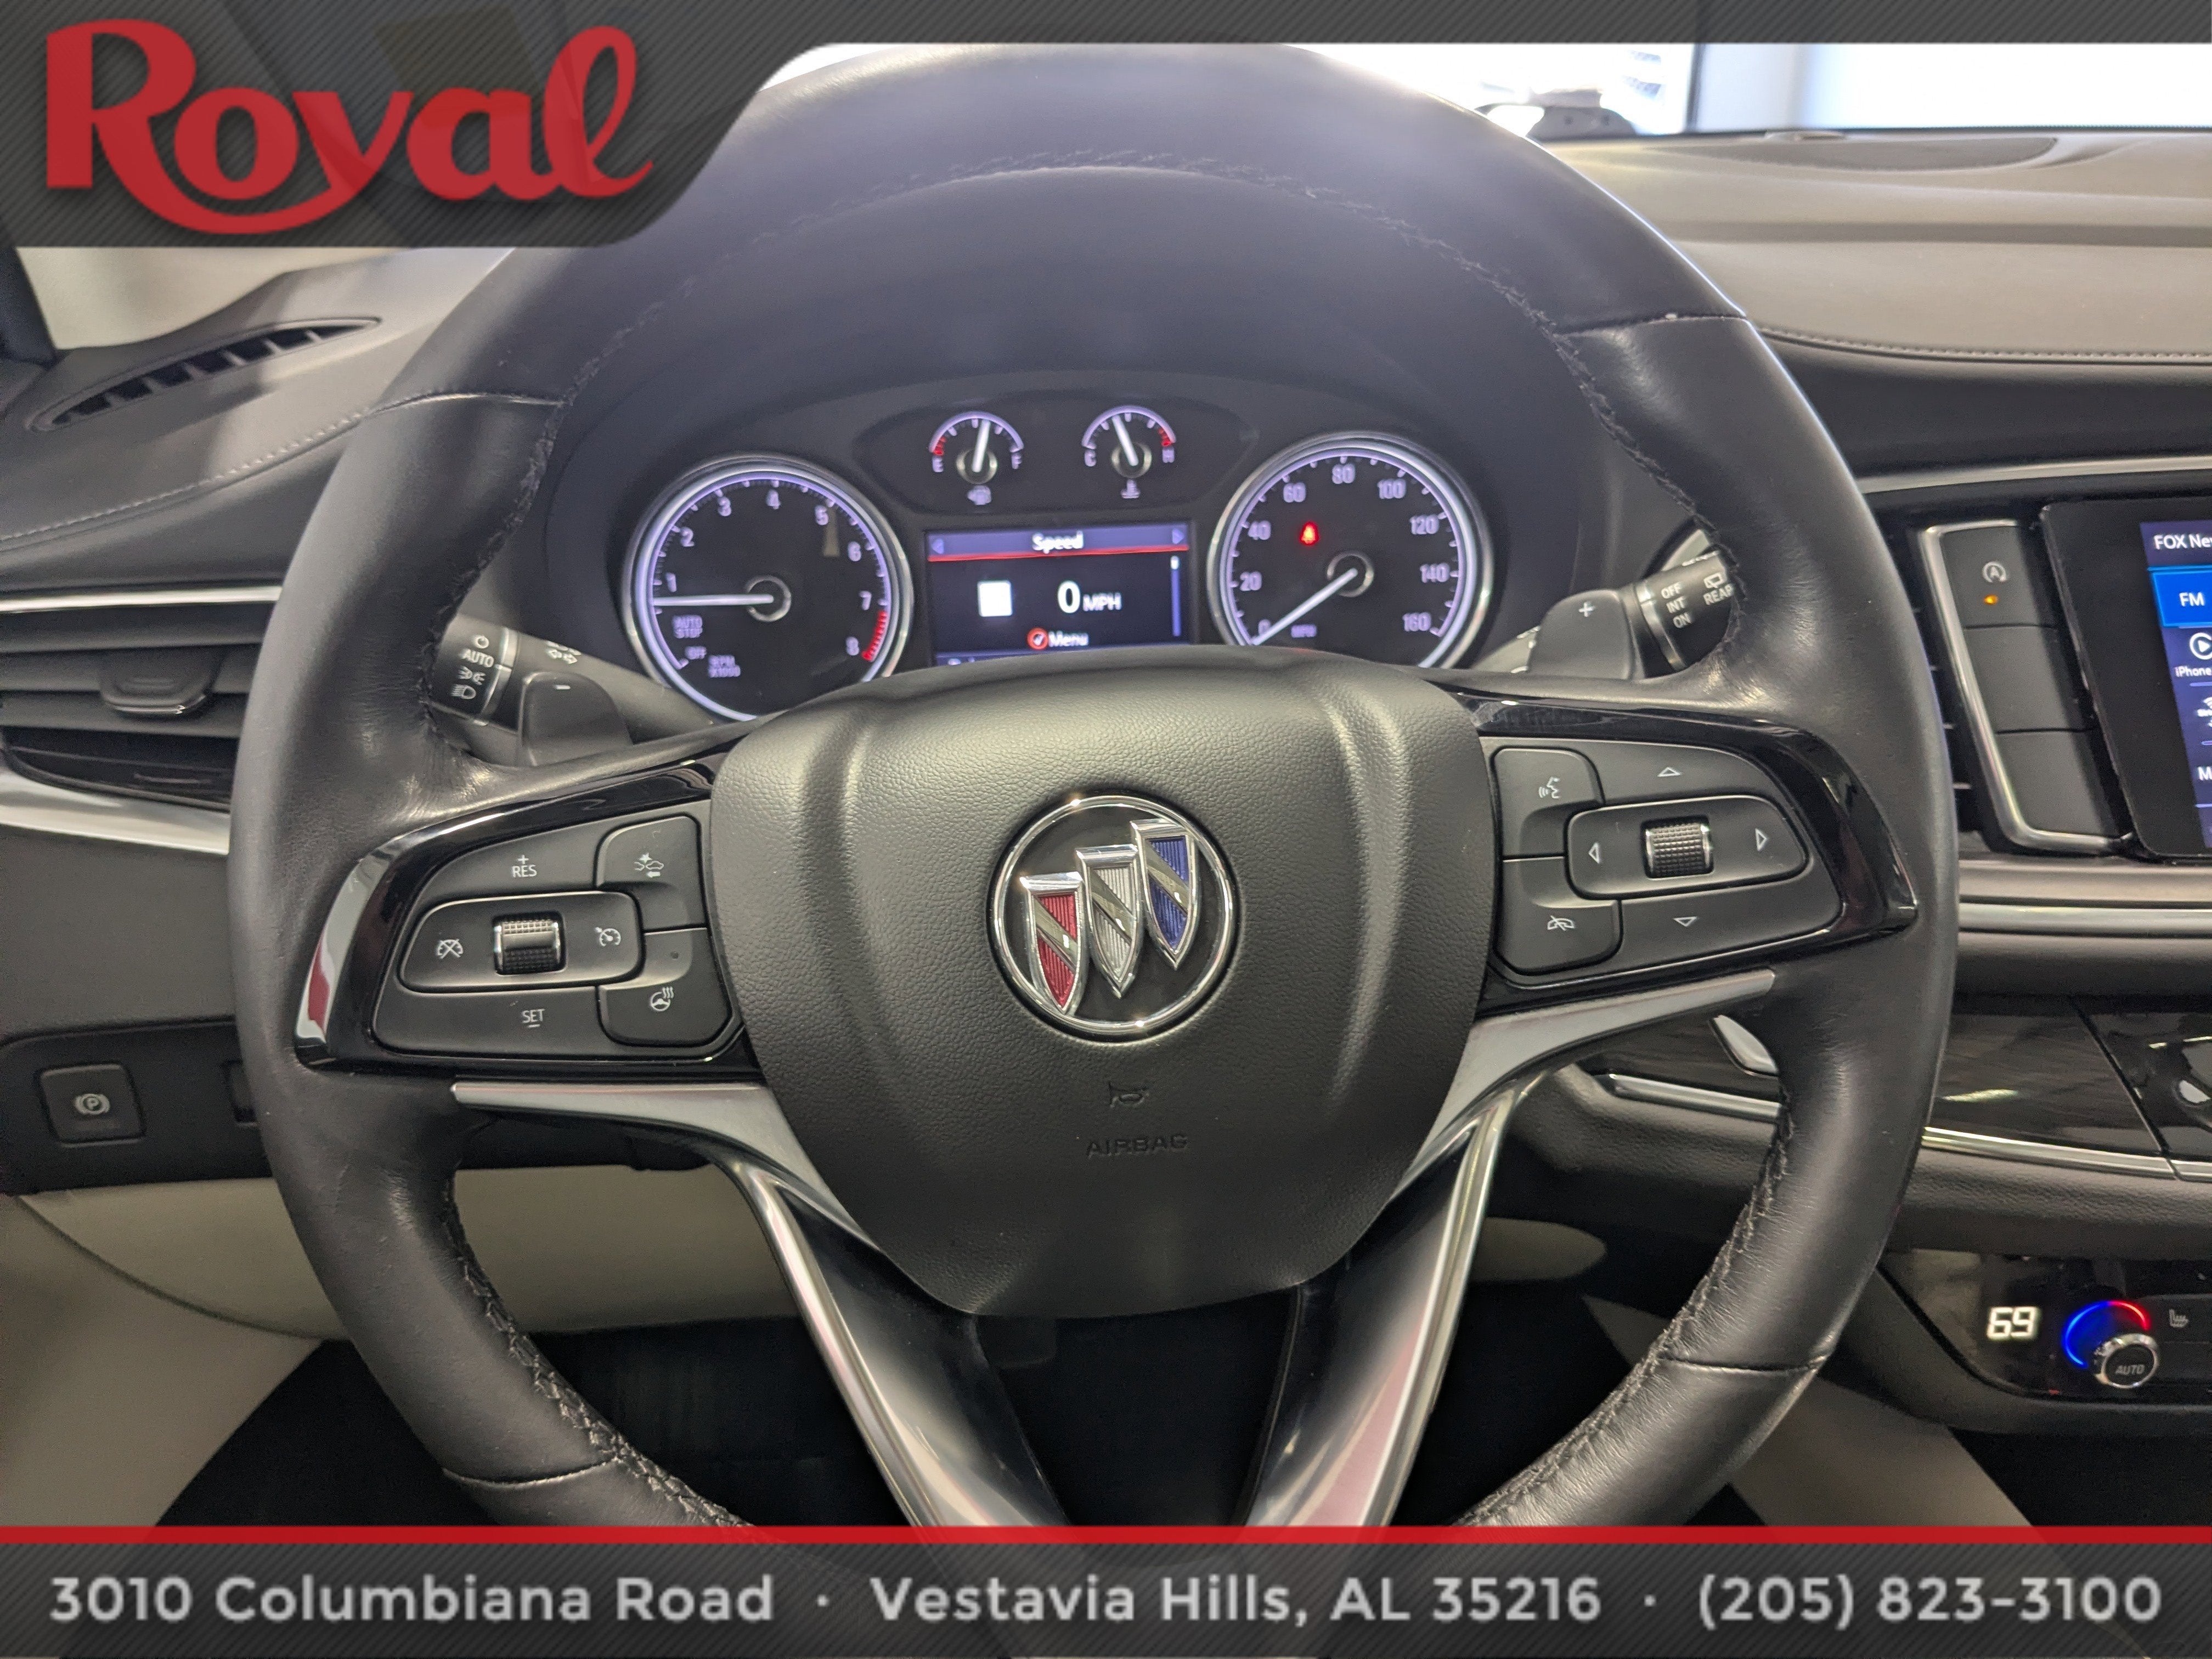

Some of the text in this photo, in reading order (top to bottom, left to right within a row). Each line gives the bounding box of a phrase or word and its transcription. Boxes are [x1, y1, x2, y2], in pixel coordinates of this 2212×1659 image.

[1331, 463, 1355, 484] 80
[1283, 482, 1306, 503] 60
[1377, 478, 1406, 499] 100
[718, 496, 732, 516] 3
[766, 490, 780, 510] 4
[815, 504, 828, 525] 5
[1409, 514, 1439, 535] 120
[679, 527, 695, 547] 2
[1248, 520, 1271, 540] 40
[847, 541, 861, 562] 6
[1032, 531, 1084, 554] Speed
[2154, 533, 2212, 550] FOX Ne
[665, 573, 676, 592] 1
[1240, 571, 1262, 591] 20
[1420, 563, 1450, 583] 140
[859, 591, 871, 610] 7
[1058, 580, 1122, 613] 0 MPH
[1661, 582, 1682, 599] OFF
[1703, 583, 1734, 605] REAR
[2179, 592, 2204, 607] FM
[1666, 596, 1685, 613] INT
[1403, 612, 1431, 632] 160
[1673, 612, 1691, 628] ON
[846, 636, 860, 656] 8
[1048, 631, 1089, 647] Menu
[462, 648, 494, 668] AUTO
[512, 865, 537, 878] RES
[522, 1009, 545, 1023] SET
[1087, 1135, 1188, 1159] AIRBAG
[1987, 1306, 2038, 1340] 69
[2116, 1364, 2145, 1375] AUTO
